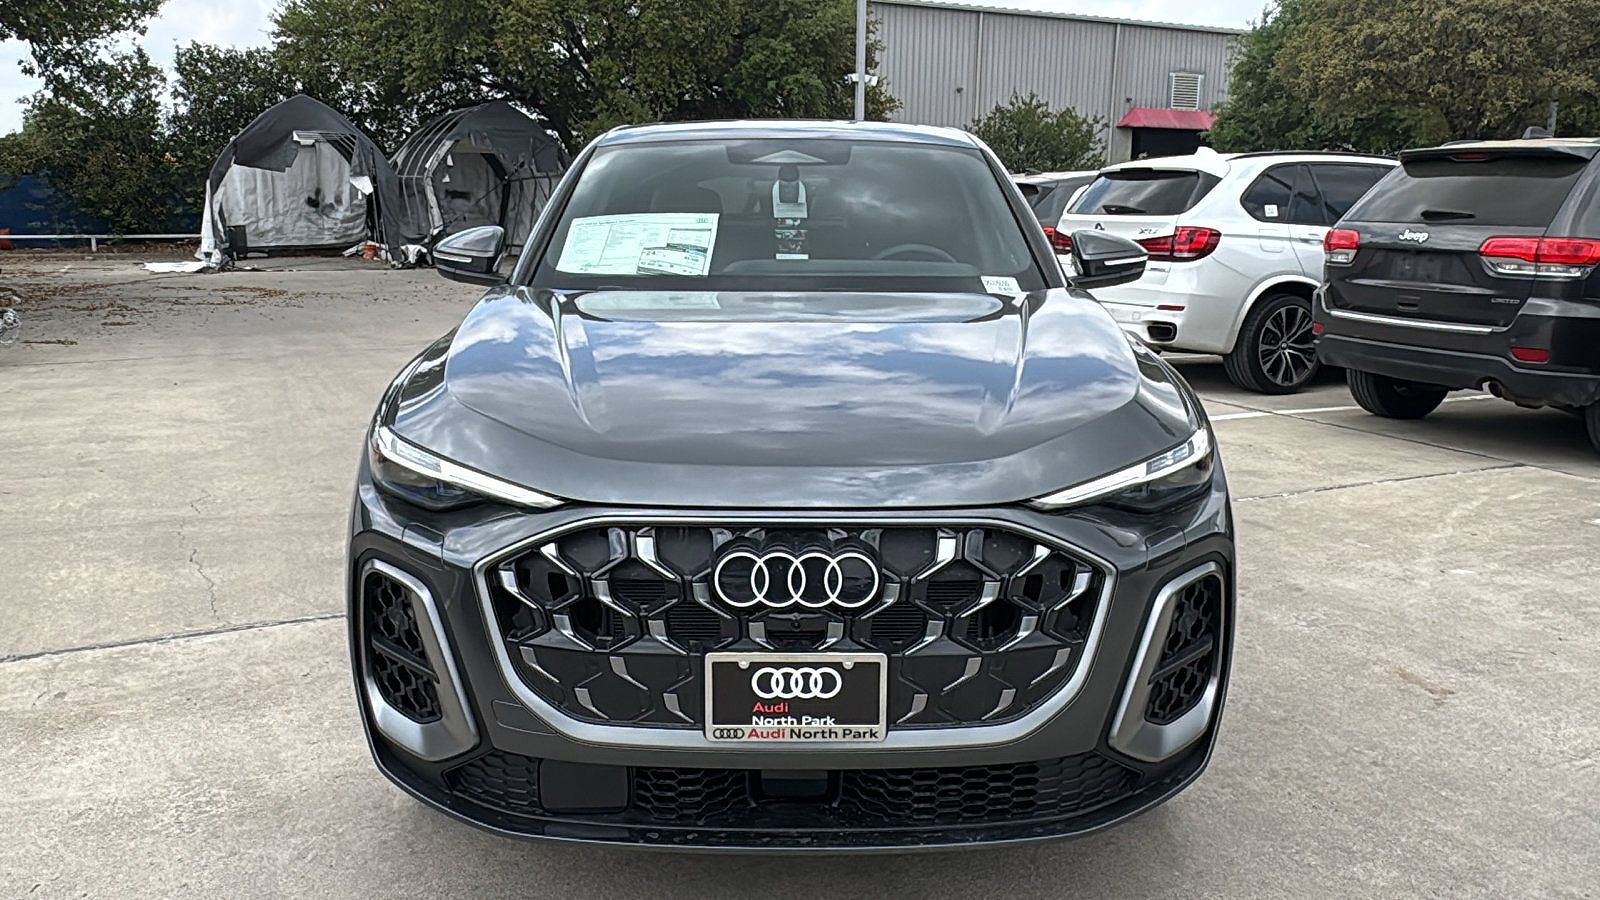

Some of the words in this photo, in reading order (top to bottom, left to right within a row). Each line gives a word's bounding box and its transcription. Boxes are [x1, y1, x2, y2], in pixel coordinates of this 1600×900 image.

[1398, 229, 1429, 243] Jeep
[752, 702, 789, 713] Audi
[752, 715, 797, 726] North
[802, 715, 836, 726] Park
[747, 728, 786, 739] Audi
[790, 728, 838, 739] North
[842, 728, 879, 739] Park
